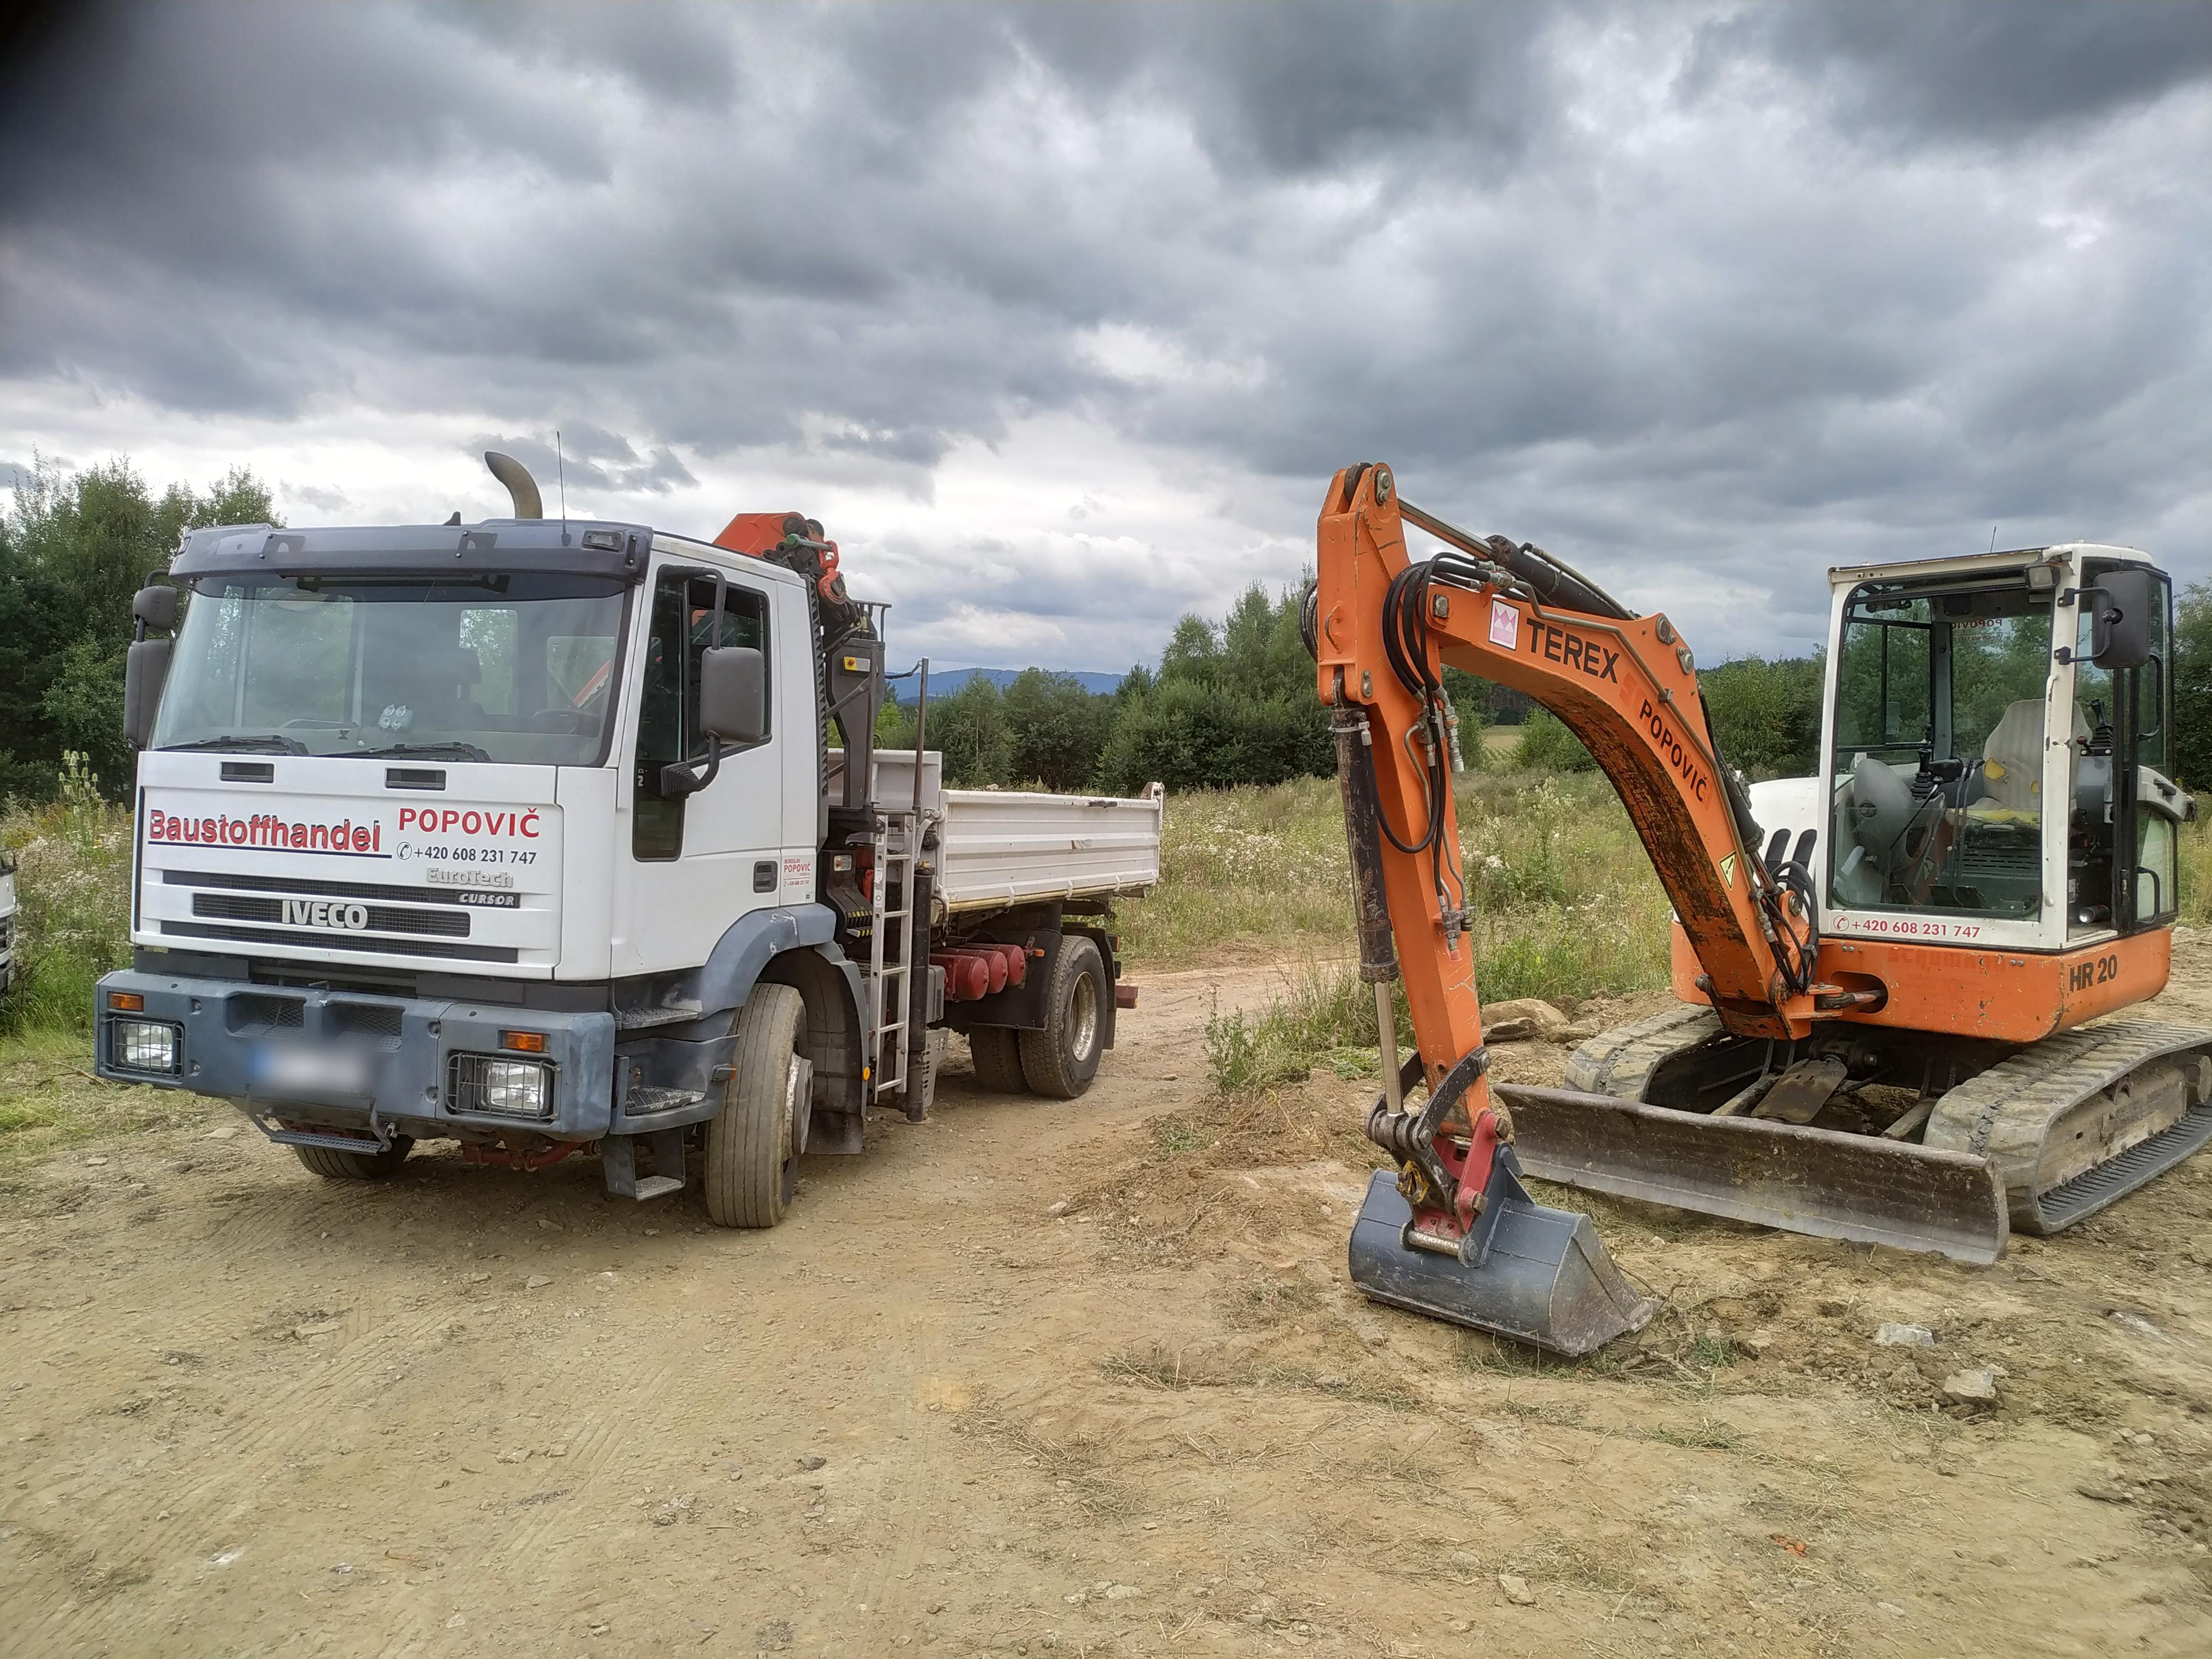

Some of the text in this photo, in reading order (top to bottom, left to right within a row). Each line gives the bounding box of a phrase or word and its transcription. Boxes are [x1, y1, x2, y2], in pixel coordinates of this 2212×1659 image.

[1526, 618, 1620, 684] TEREX
[1639, 698, 1708, 802] POPOVIČ
[150, 809, 380, 852] Baustoffhandel
[399, 807, 540, 838] POPOVIČ
[414, 846, 537, 864] +420 608 231 747
[784, 862, 811, 873] POPOVIČ
[426, 867, 513, 888] EuroTech
[458, 893, 514, 905] CURSOR
[282, 900, 368, 929] IVECO
[1852, 920, 1980, 938] +420 608 231 747
[2069, 954, 2117, 992] HR 20
